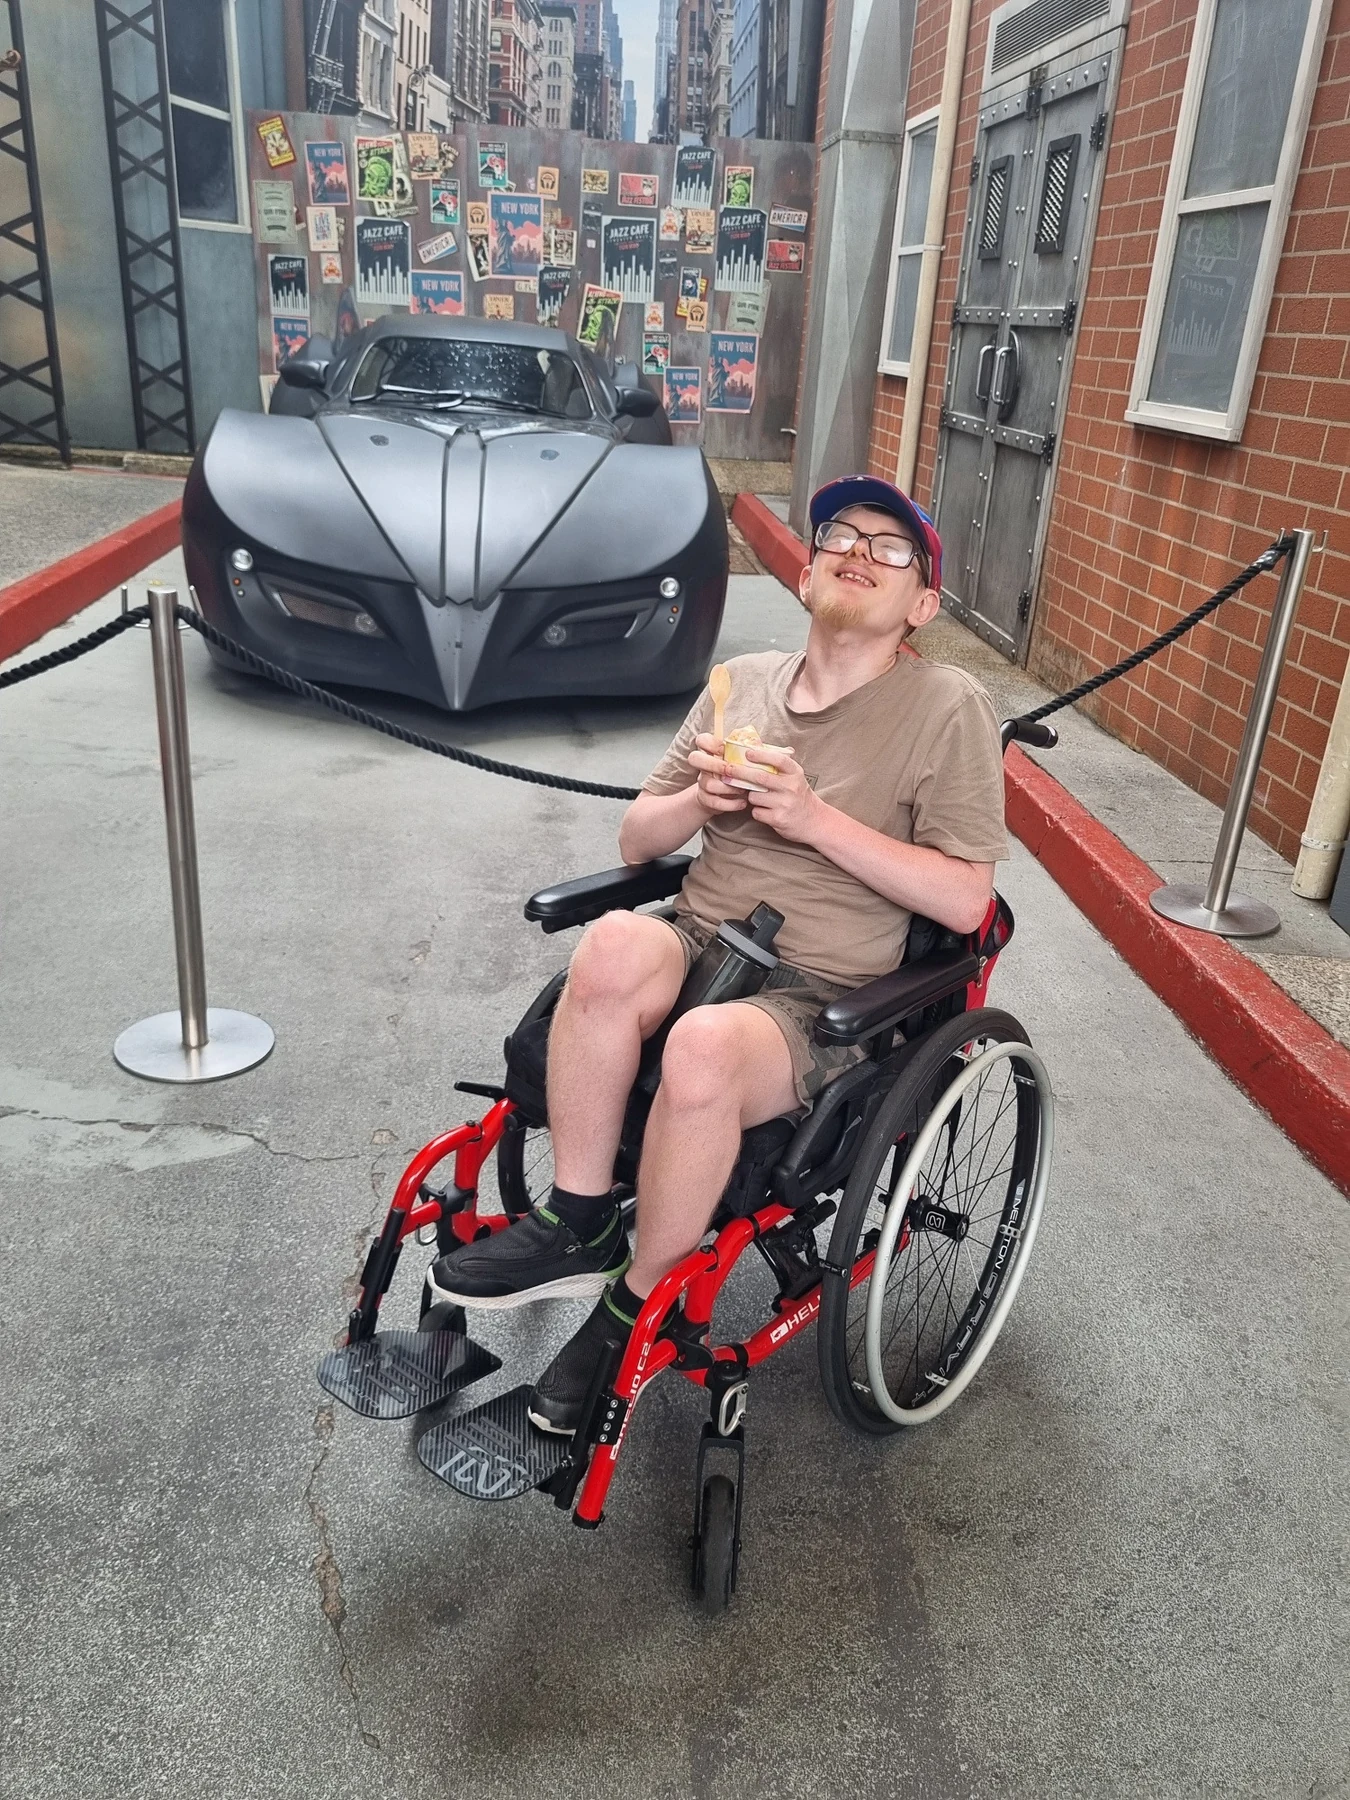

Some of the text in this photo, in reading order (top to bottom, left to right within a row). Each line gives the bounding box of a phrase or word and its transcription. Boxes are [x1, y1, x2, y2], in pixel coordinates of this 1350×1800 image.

[314, 148, 341, 157] NEW YORK
[682, 151, 711, 160] JAZZ CAFE
[501, 202, 539, 215] NEW YORK
[721, 213, 762, 228] JAZZ CAFE
[772, 211, 803, 224] AMERICA
[363, 225, 403, 239] JAZZ CAFE
[610, 223, 650, 239] JAZZ CAFE
[422, 236, 450, 259] AMERICA
[275, 260, 303, 270] JAZZ CAFE
[421, 279, 460, 292] NEW YORK
[280, 322, 307, 332] NEW YORK
[718, 340, 754, 353] NEW YORK
[672, 372, 698, 381] NEW YORK
[637, 1342, 652, 1372] C2
